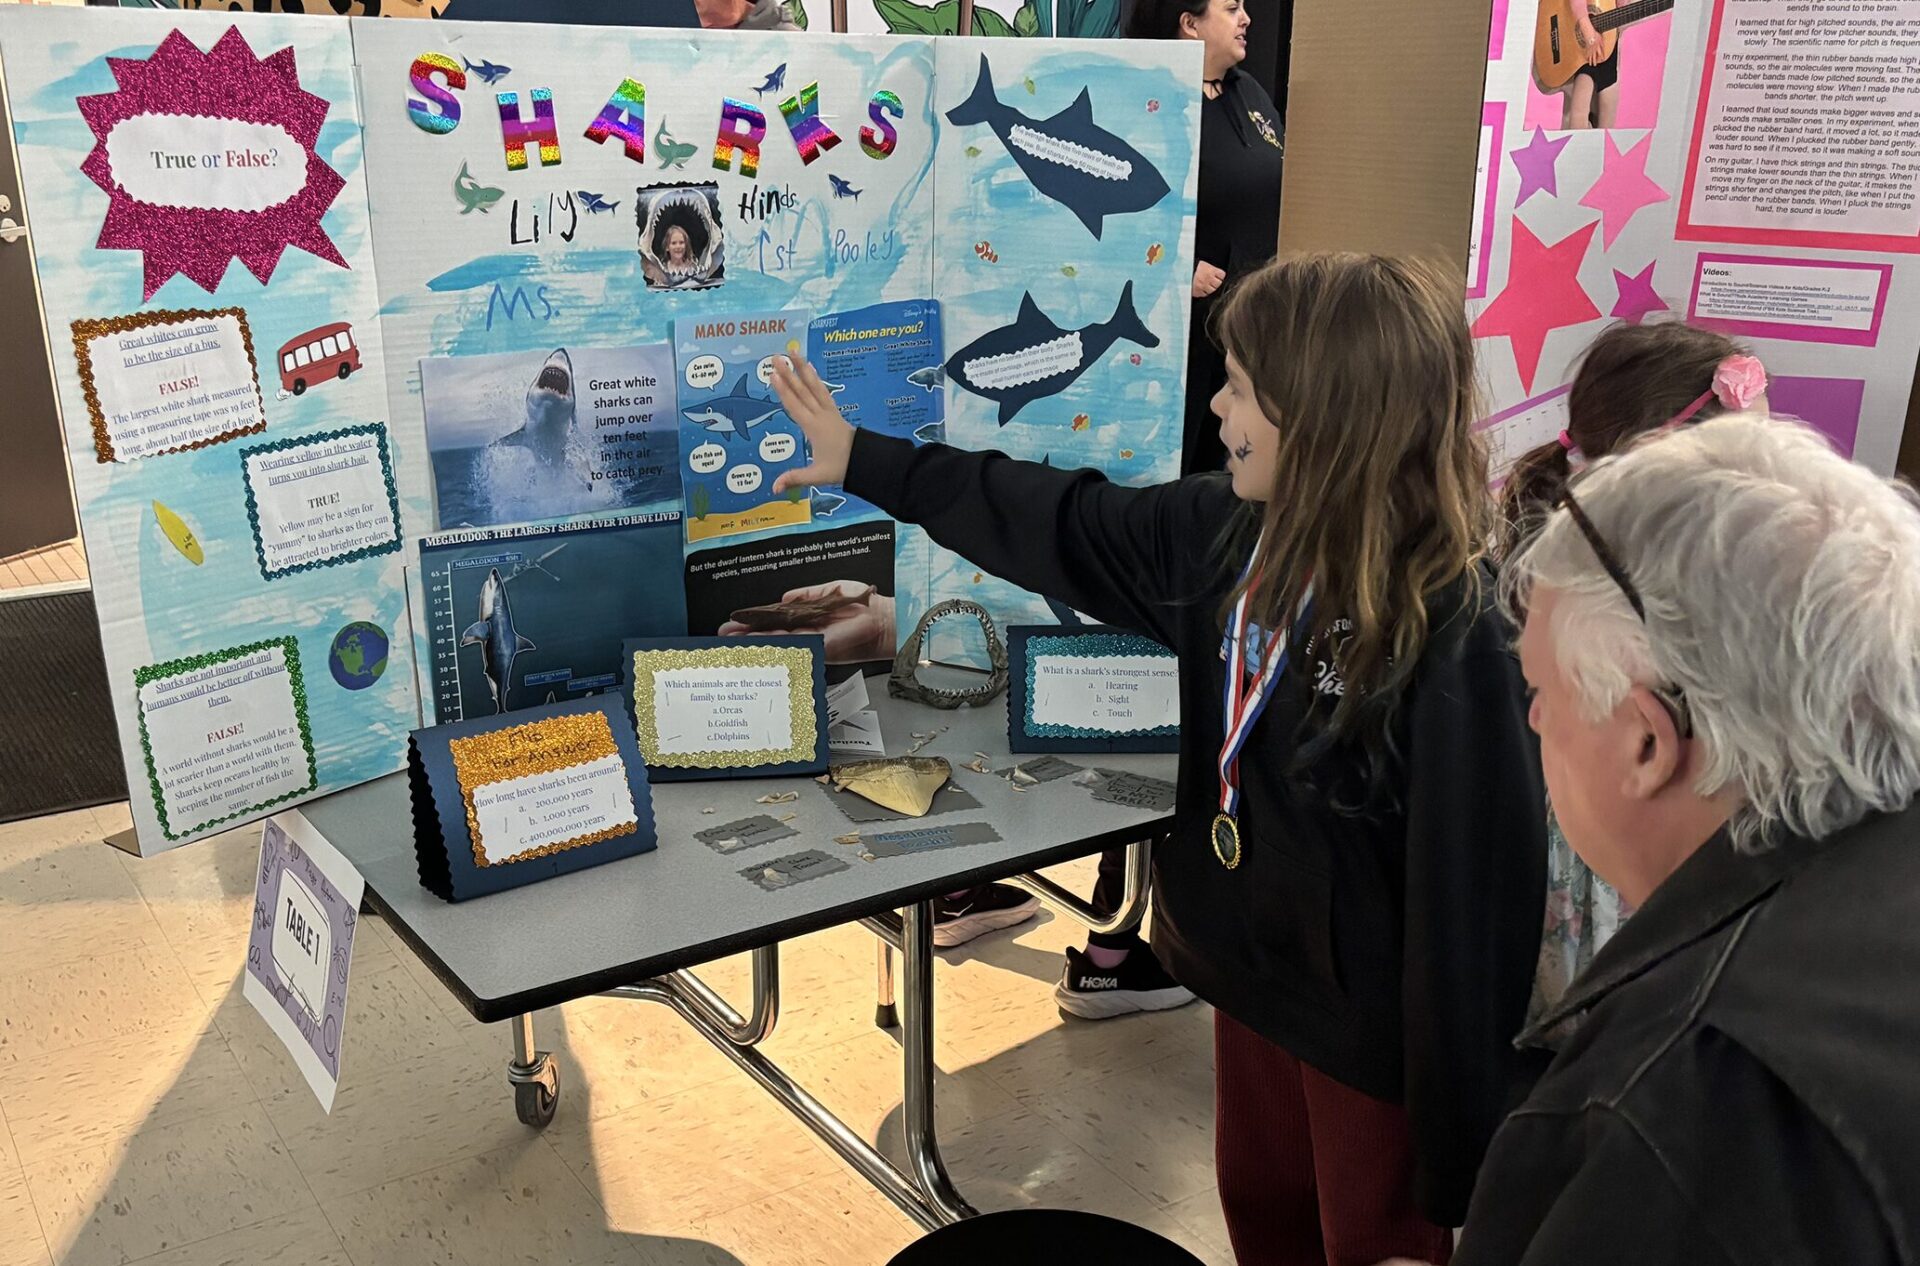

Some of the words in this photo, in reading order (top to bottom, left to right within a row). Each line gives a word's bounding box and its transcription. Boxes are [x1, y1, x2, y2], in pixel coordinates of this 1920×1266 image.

[1799, 19, 1815, 28] high
[1817, 19, 1846, 28] pitched
[408, 51, 904, 178] SHARKS
[151, 150, 197, 169] True
[201, 153, 220, 168] or
[226, 148, 279, 168] False?
[738, 184, 796, 224] Hinds
[510, 190, 579, 245] Lily
[1703, 268, 1731, 276] Videos:
[485, 283, 561, 332] Ms.
[119, 337, 145, 350] Great
[146, 330, 176, 344] whites
[178, 328, 193, 337] can
[195, 323, 218, 337] grow
[695, 322, 736, 340] MAKO
[740, 319, 786, 335] SHARK
[824, 331, 857, 343] Which
[858, 329, 878, 340] one
[879, 328, 896, 338] are
[898, 322, 924, 336] you?
[884, 342, 898, 350] Great
[159, 376, 199, 395] FALSE!
[590, 379, 621, 390] Great
[624, 376, 656, 388] white
[112, 413, 129, 425] The
[131, 406, 160, 420] largest
[161, 399, 185, 413] white
[187, 393, 210, 407] shark
[212, 384, 251, 401] measured
[594, 395, 630, 408] sharks
[634, 396, 652, 405] can
[595, 415, 625, 429] jump
[628, 414, 653, 423] over
[603, 434, 621, 444] ten
[625, 430, 647, 440] feet
[601, 451, 611, 461] in
[615, 449, 632, 460] the
[637, 449, 650, 458] air
[591, 471, 602, 480] to
[606, 466, 635, 479] catch
[639, 465, 665, 477] prey.
[308, 492, 341, 508] TRUE!
[279, 521, 305, 534] Yellow
[308, 515, 324, 526] may
[325, 512, 336, 521] be
[344, 508, 360, 518] sign
[362, 502, 374, 512] for
[426, 533, 492, 547] MEGALODON:
[493, 529, 513, 539] THE
[514, 524, 558, 537] LARGEST
[558, 521, 591, 532] SHARK
[593, 519, 616, 529] EVER
[618, 517, 630, 526] TO
[631, 514, 653, 524] HAVE
[655, 512, 680, 522] LIVED
[455, 556, 500, 567] MEGALODON
[691, 564, 703, 572] But
[704, 561, 716, 569] the
[717, 557, 738, 567] dwarf
[739, 552, 764, 563] lantern
[766, 549, 785, 559] shark
[793, 543, 823, 555] probably
[825, 541, 835, 549] the
[837, 536, 861, 546] world's
[863, 533, 890, 543] smallest
[712, 569, 740, 580] species,
[741, 562, 777, 573] measuring
[779, 557, 804, 568] smaller
[805, 554, 821, 562] than
[828, 550, 850, 559] human
[852, 546, 870, 555] hand.
[1043, 666, 1064, 675] What
[1081, 666, 1110, 675] shark's
[1112, 668, 1150, 678] strongest
[664, 680, 690, 688] Which
[755, 679, 782, 687] closest
[1105, 681, 1138, 690] Hearing
[690, 693, 715, 702] family
[728, 692, 758, 701] sharks?
[1108, 695, 1129, 704] Sight
[1107, 709, 1132, 717] Touch
[207, 722, 244, 743] FALSE!
[164, 779, 174, 790] lot
[176, 770, 204, 787] scarier
[206, 762, 224, 775] than
[232, 751, 254, 767] world
[256, 747, 272, 760] with
[274, 740, 296, 754] them.
[476, 799, 494, 808] How
[496, 791, 515, 802] long
[516, 786, 536, 798] have
[538, 779, 566, 792] sharks
[567, 772, 587, 783] been
[589, 762, 621, 779] around?
[519, 805, 526, 813] a.
[536, 793, 569, 808] 200,000
[571, 788, 594, 800] years
[529, 816, 538, 826] b.
[544, 810, 566, 822] 1,000
[567, 804, 590, 817] years
[529, 822, 582, 842] 400,000,000
[584, 815, 605, 828] years
[286, 897, 312, 958] TABLE
[314, 934, 320, 965] 1
[1080, 976, 1118, 988] HOKA
